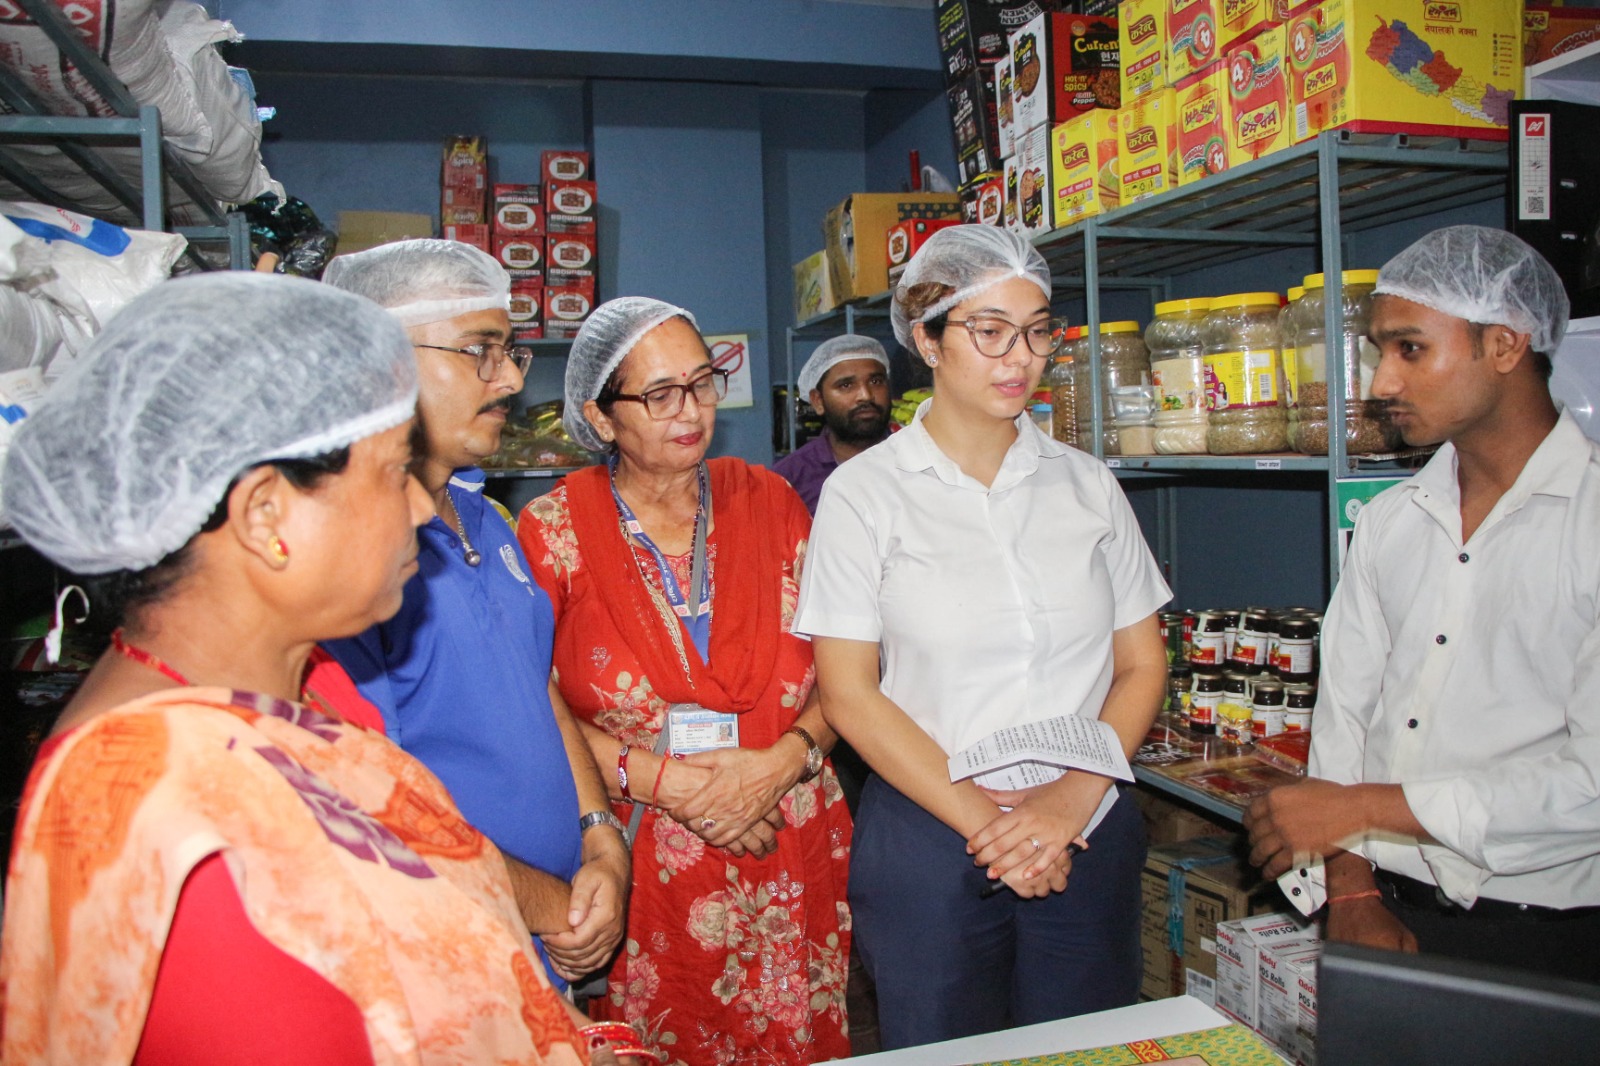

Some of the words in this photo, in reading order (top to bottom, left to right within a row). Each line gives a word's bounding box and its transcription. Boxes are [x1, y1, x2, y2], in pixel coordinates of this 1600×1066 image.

[1425, 23, 1454, 35] नेपालको
[1074, 37, 1119, 53] Curren
[1295, 31, 1305, 52] 4
[1233, 62, 1244, 83] 4
[1073, 97, 1096, 105] Pepper
[1129, 131, 1153, 148] करेन्ट
[1064, 147, 1087, 164] करेन्ट
[1258, 928, 1280, 938] Rolls
[1280, 925, 1298, 935] POS
[1228, 948, 1241, 963] Rolls
[1271, 972, 1285, 988] Rolls
[1298, 991, 1310, 1008] POS
